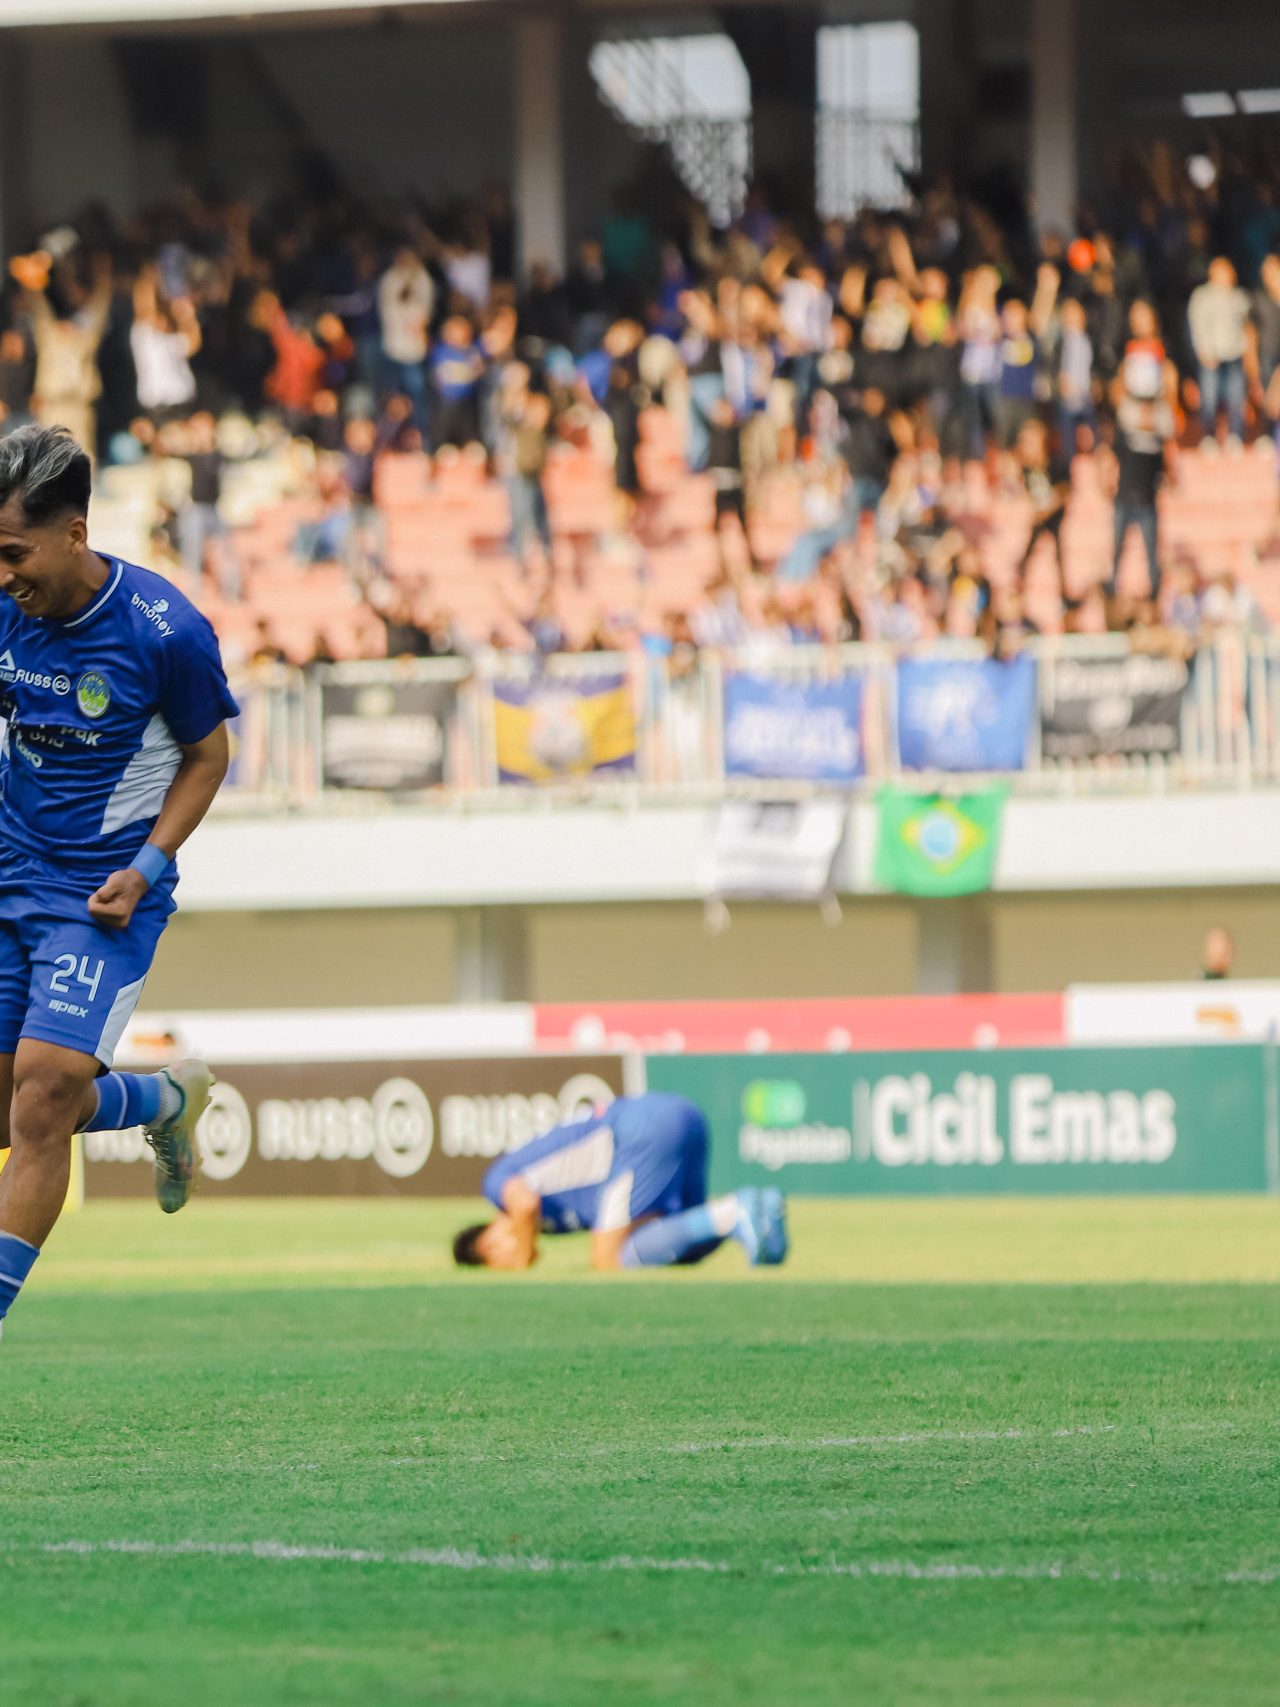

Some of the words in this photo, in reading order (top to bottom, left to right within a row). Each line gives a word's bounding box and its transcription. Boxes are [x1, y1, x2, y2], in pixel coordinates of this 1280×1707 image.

[130, 592, 175, 639] bmoney
[49, 953, 105, 1002] 24
[48, 999, 89, 1018] apex
[871, 1071, 1004, 1167] Cicil
[1009, 1073, 1177, 1165] Emas
